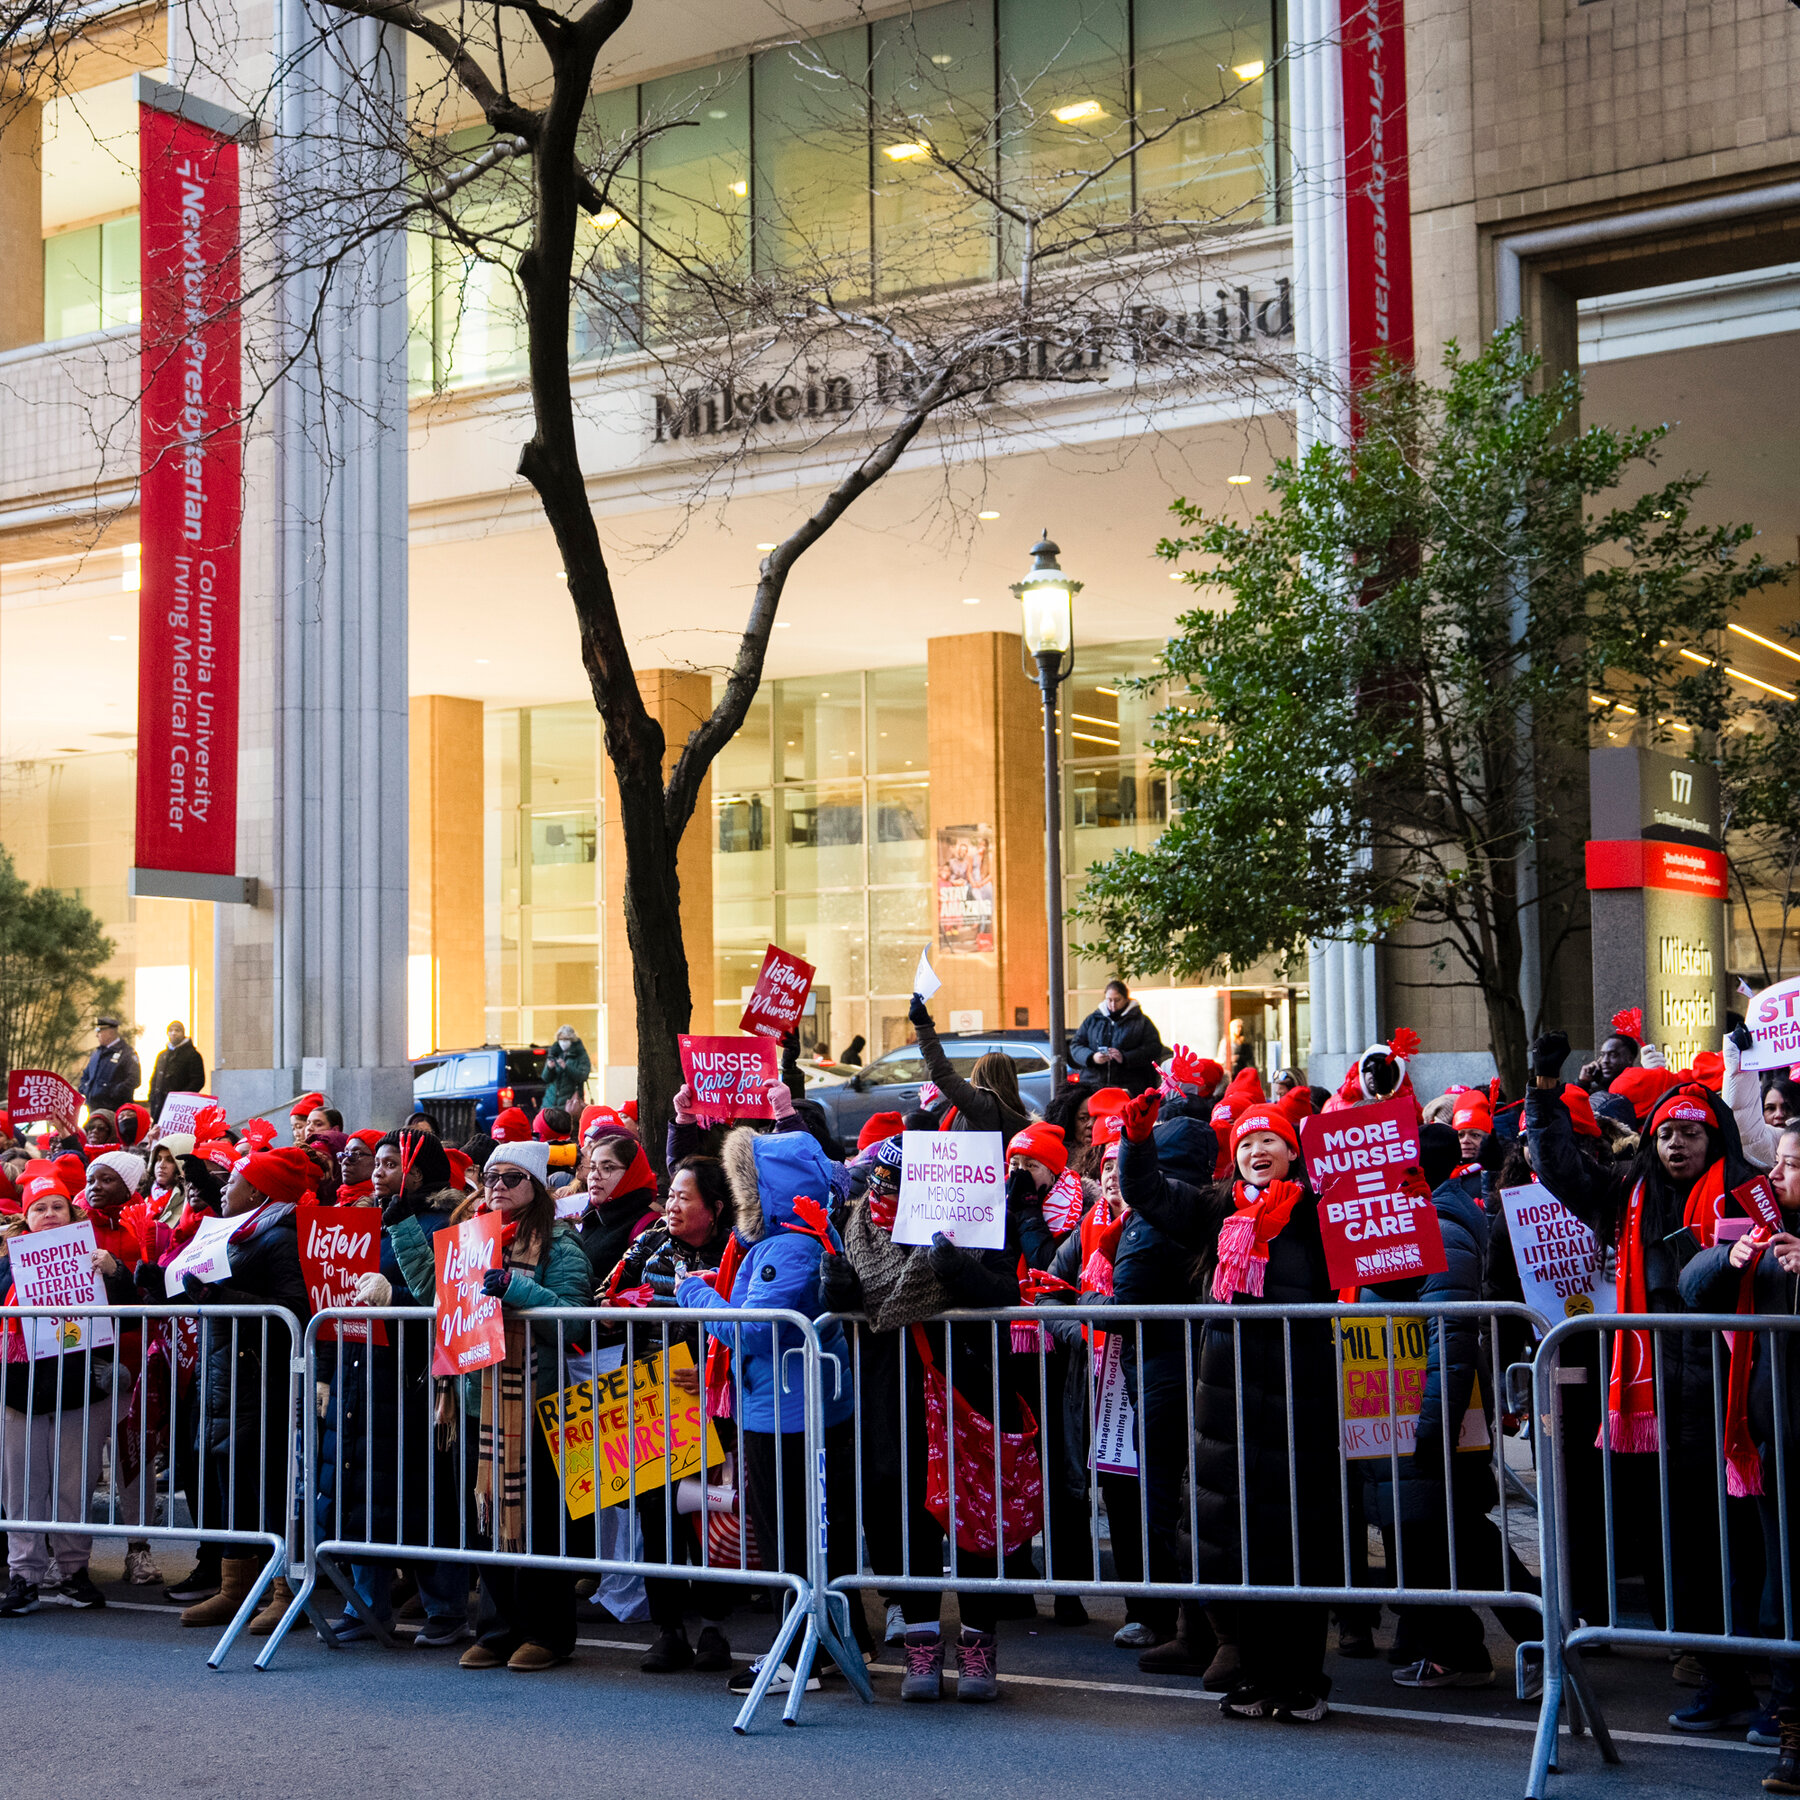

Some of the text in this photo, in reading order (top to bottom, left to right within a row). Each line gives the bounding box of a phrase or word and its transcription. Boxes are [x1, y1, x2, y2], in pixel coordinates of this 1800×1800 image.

[650, 364, 855, 443] Milstein
[168, 555, 193, 833] Irving Medical Center
[188, 560, 216, 823] Columbia University
[1670, 769, 1692, 805] 177
[1661, 937, 1713, 976] Milstein
[751, 995, 801, 1021] Nurses!
[1661, 990, 1716, 1036] Hospital
[691, 1052, 762, 1071] NURSES
[24, 1075, 74, 1103] NURSES
[737, 1070, 763, 1093] for
[12, 1106, 46, 1117] HEALTH
[18, 1085, 75, 1115] DESERVE
[29, 1095, 67, 1115] GOOD
[697, 1091, 763, 1105] NEW YORK
[932, 1137, 958, 1160] MÁS
[1323, 1119, 1400, 1151] MORE
[1313, 1139, 1418, 1176] NURSES
[907, 1163, 996, 1184] ENFERMERAS
[927, 1186, 965, 1203] MENOS
[1326, 1192, 1427, 1223] BETTER
[1750, 1184, 1777, 1222] NYSNA
[1344, 1212, 1416, 1242] CARE
[1535, 1218, 1586, 1243] EXEC$
[20, 1240, 89, 1267] HOSPITAL
[1355, 1249, 1421, 1272] NURSES
[37, 1258, 79, 1281] EXEC$
[1358, 1261, 1424, 1277] ASSOCIATION
[1533, 1257, 1582, 1283] MAKE
[24, 1271, 96, 1298] LITERALLY
[32, 1287, 95, 1307] MAKE US
[1554, 1275, 1596, 1298] SICK
[538, 1354, 665, 1431] RESPECT.
[1097, 1392, 1114, 1460] Management's
[1112, 1413, 1128, 1463] bargaining
[603, 1406, 703, 1475] NURSES
